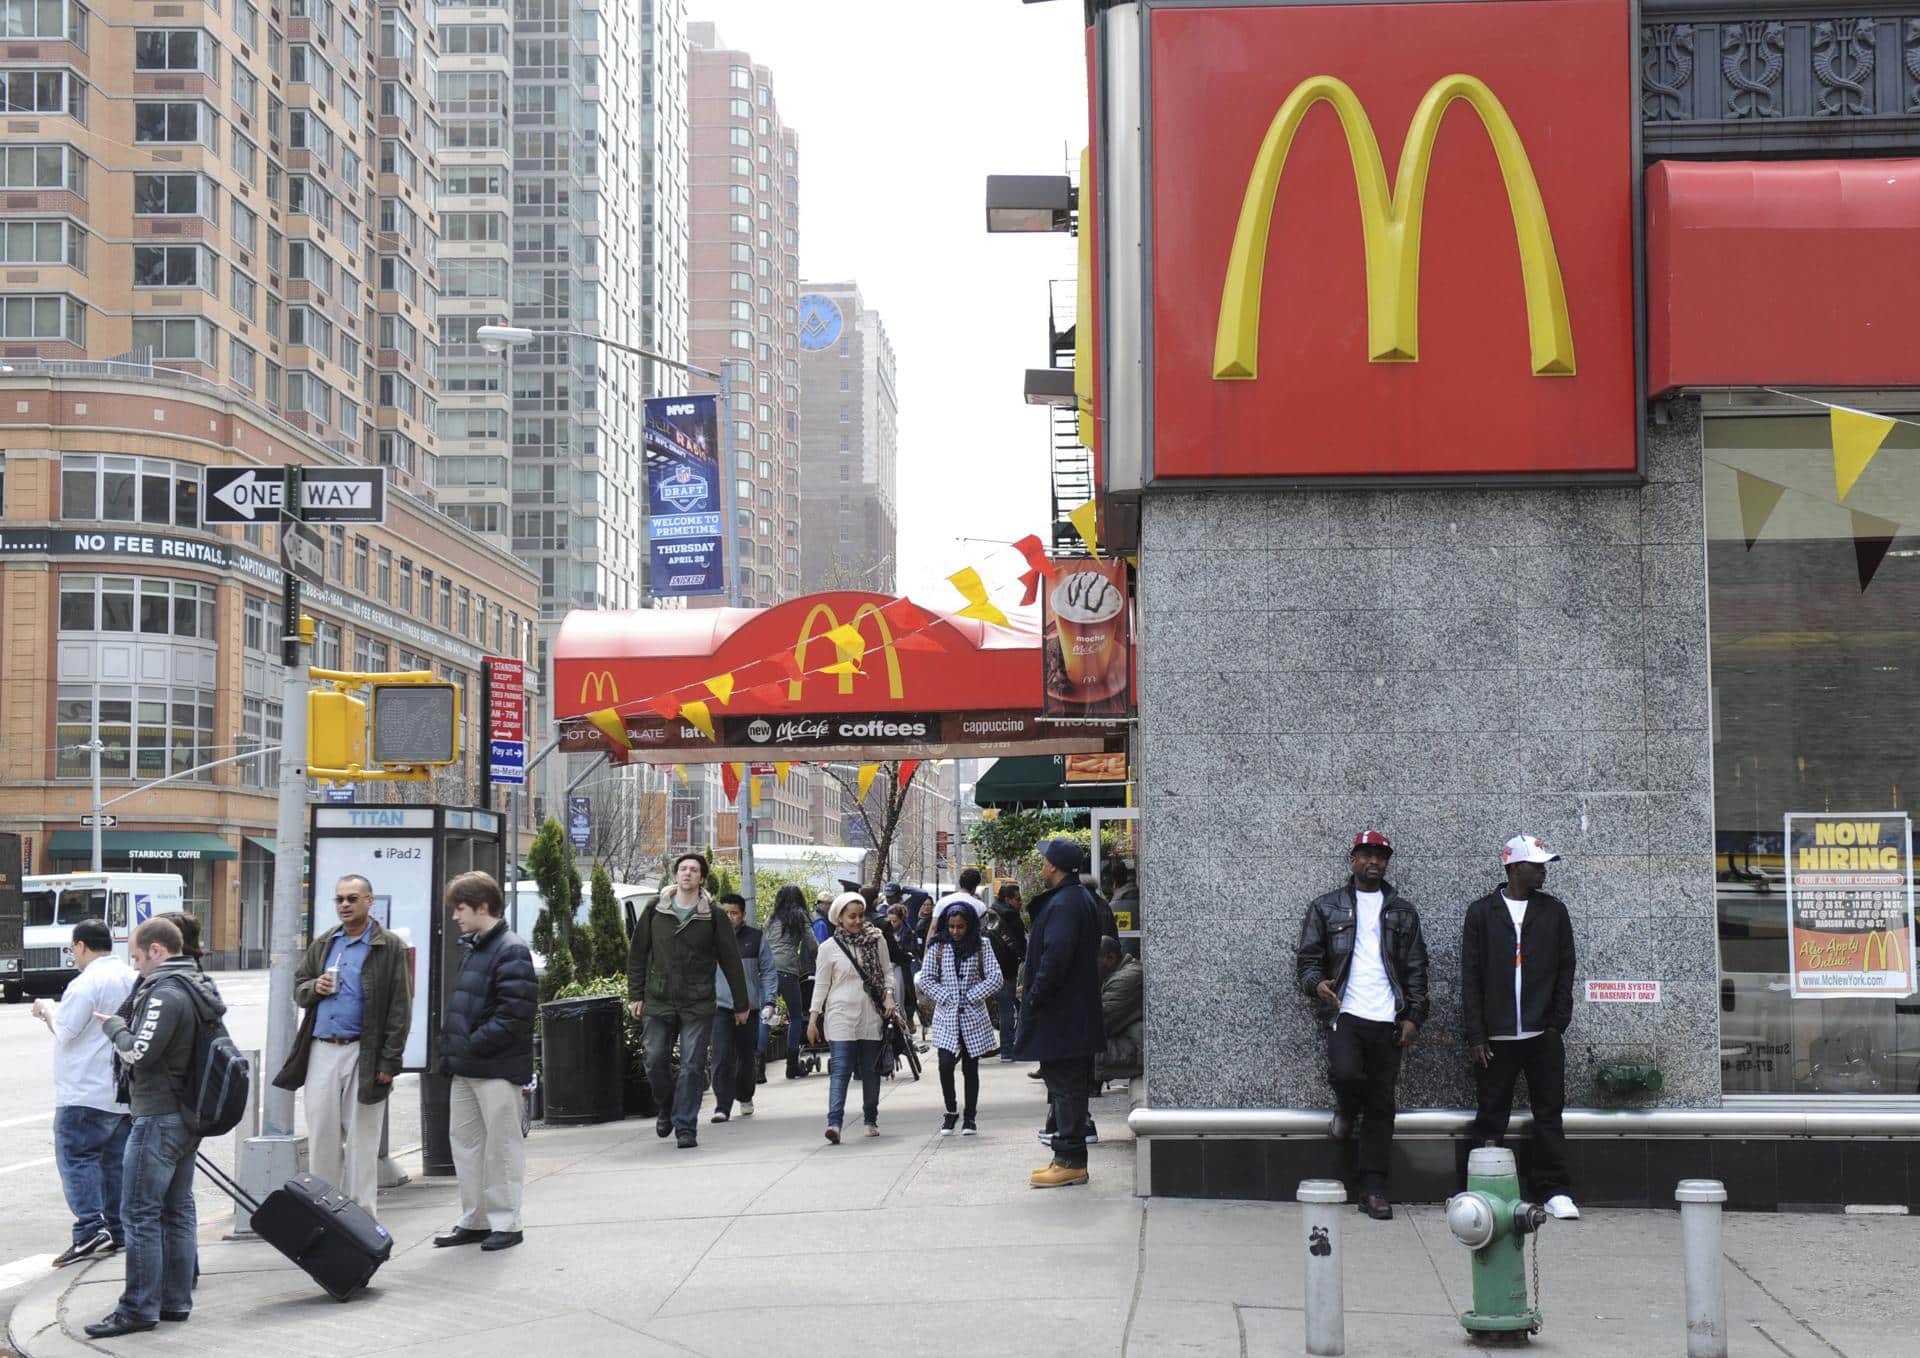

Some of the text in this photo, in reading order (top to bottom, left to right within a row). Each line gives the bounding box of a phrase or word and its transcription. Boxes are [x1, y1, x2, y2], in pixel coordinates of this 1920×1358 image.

[666, 404, 695, 416] NYC
[233, 484, 360, 505] ONE WAY
[664, 485, 704, 497] DRAFT
[653, 515, 719, 527] WELCOME TO
[656, 525, 718, 537] PRIMETIME
[74, 534, 105, 550] NO
[114, 536, 154, 553] FEE
[657, 542, 715, 555] THURSDAY
[668, 555, 694, 565] APRIL
[669, 574, 705, 586] SNICKERS
[491, 709, 500, 718] AM
[505, 710, 518, 719] 7PM
[750, 726, 770, 736] new
[776, 720, 829, 743] McCafé
[838, 720, 926, 737] coffees
[963, 719, 1024, 735] cappuccino
[492, 746, 504, 757] Pay
[348, 811, 405, 826] TITAN
[1815, 822, 1880, 846] NOW
[128, 850, 201, 859] STARBUCKS COFFEE
[385, 848, 421, 859] iPad 2
[1799, 847, 1898, 871] HIRING
[1800, 936, 1859, 957] Also Apply
[1802, 974, 1887, 986] www.McNewYork.com/
[1589, 983, 1657, 991] SPRINKLER SYSTEM
